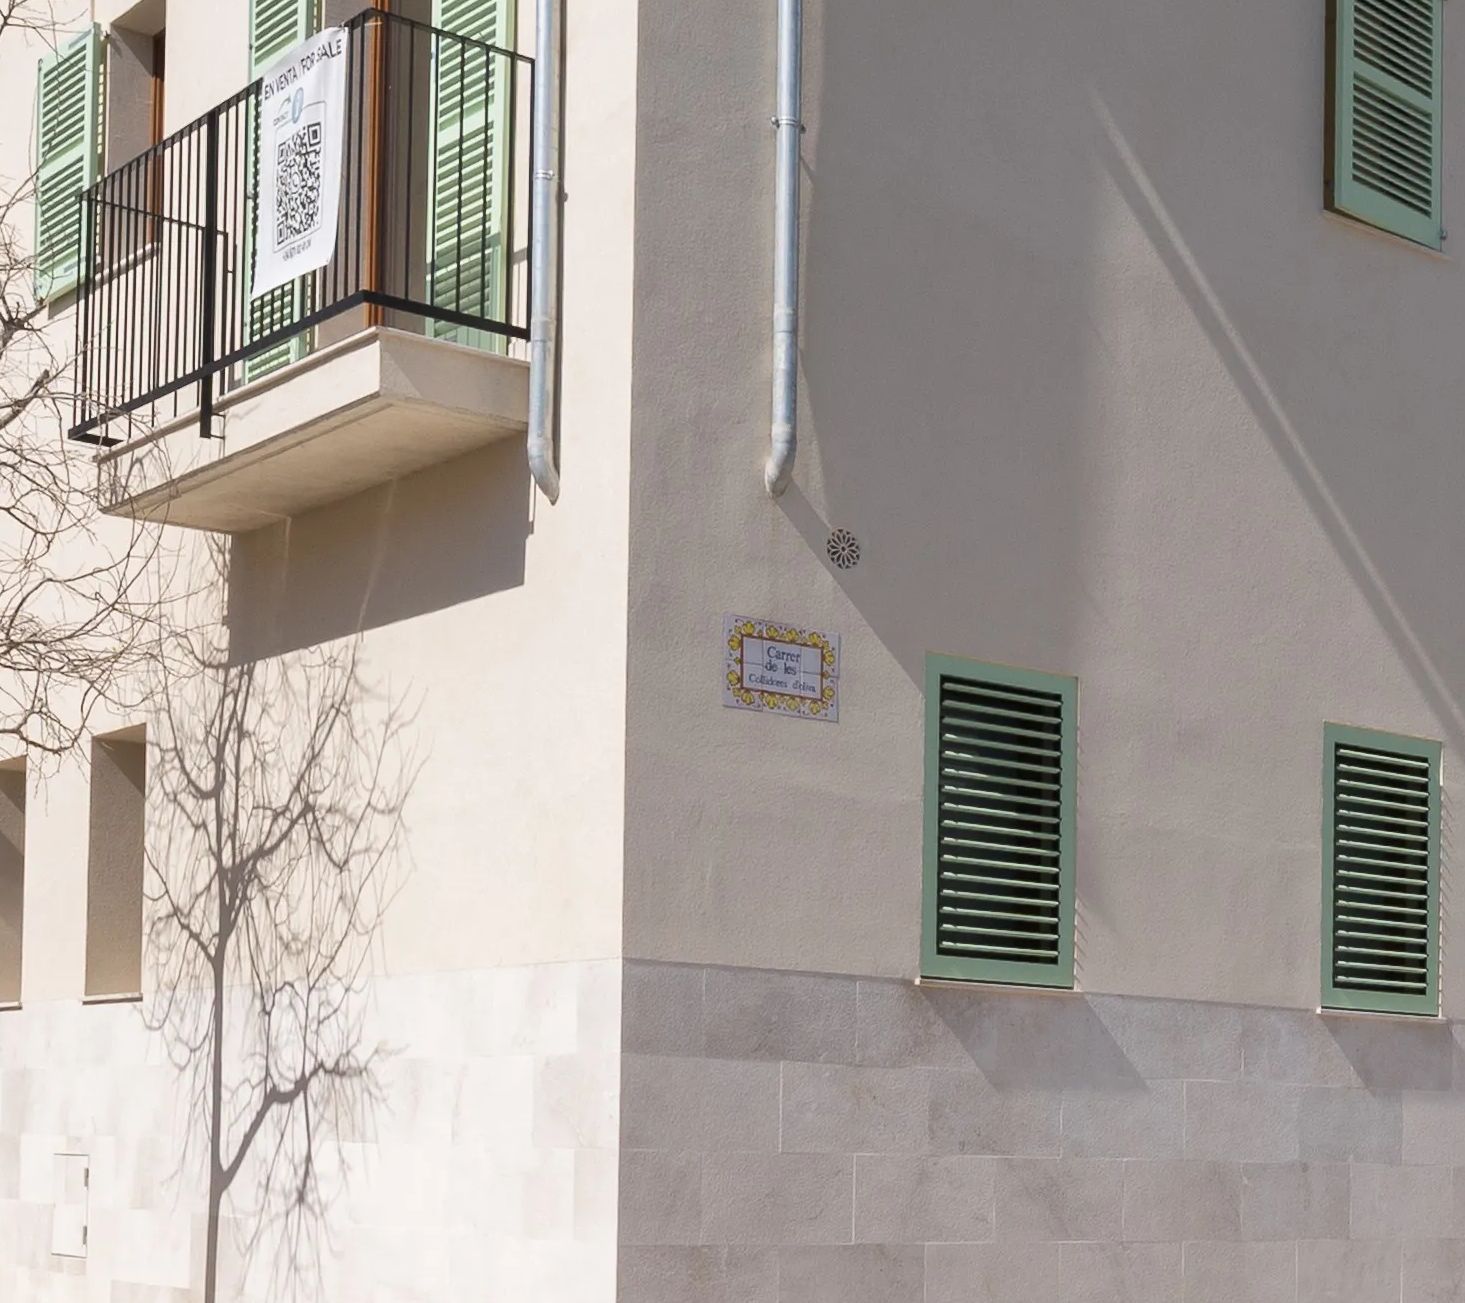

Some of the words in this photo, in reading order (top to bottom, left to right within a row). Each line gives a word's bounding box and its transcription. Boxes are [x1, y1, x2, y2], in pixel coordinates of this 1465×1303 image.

[264, 80, 275, 100] EN
[275, 65, 299, 93] VENTA
[301, 52, 315, 74] FOR
[316, 39, 342, 62] SALE
[767, 646, 800, 662] Carrer
[765, 659, 778, 672] de
[783, 662, 797, 676] les
